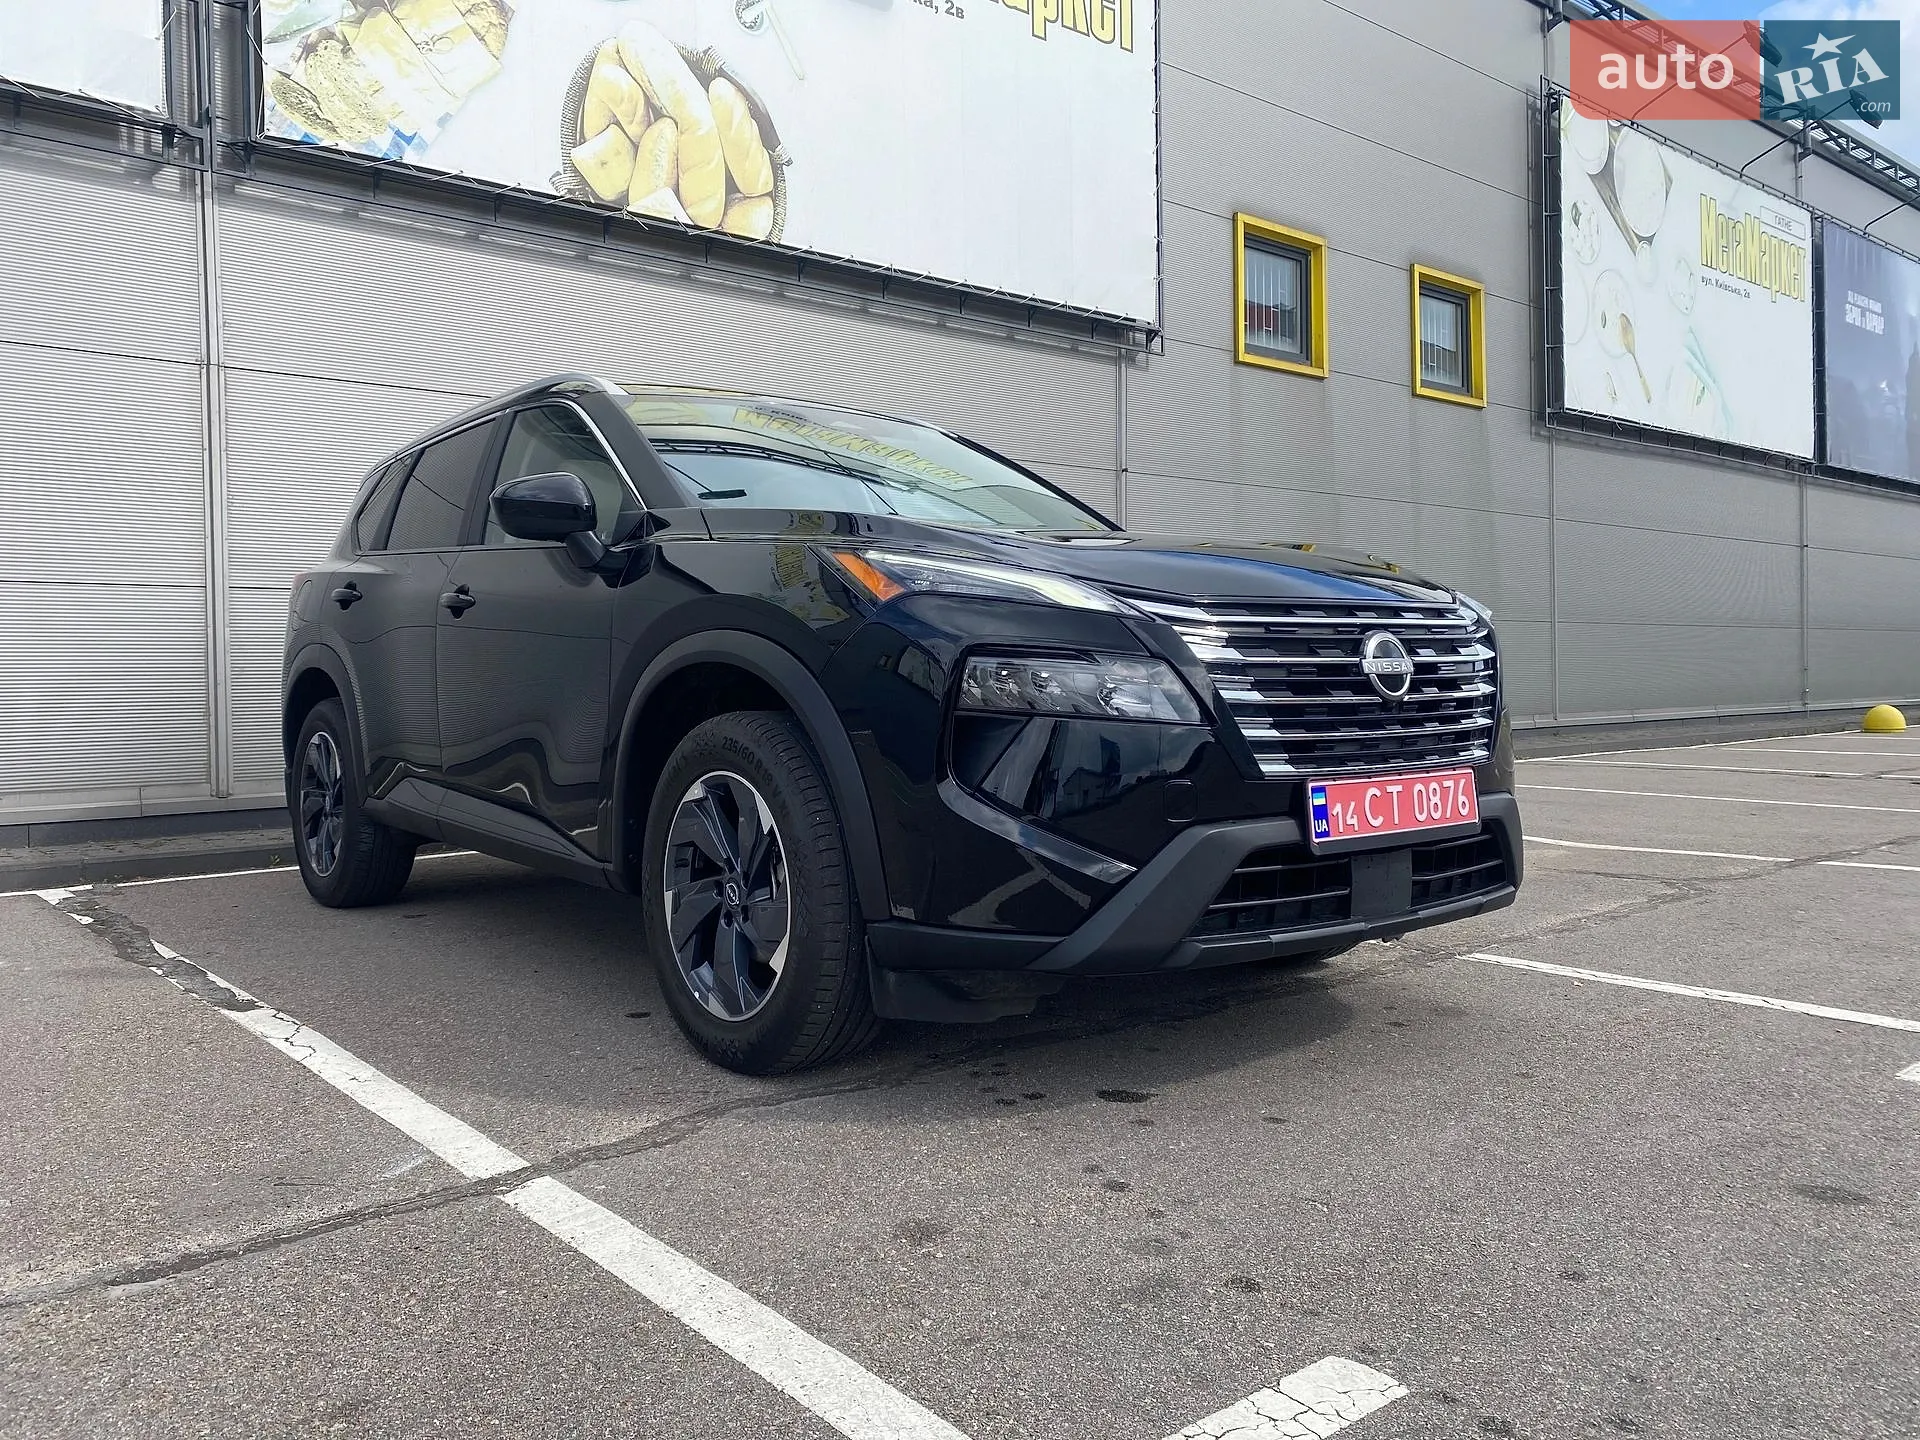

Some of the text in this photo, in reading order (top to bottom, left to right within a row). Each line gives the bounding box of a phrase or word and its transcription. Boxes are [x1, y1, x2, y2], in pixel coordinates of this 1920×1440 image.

[1700, 193, 1806, 303] МегаМаркет
[1413, 778, 1470, 822] 0876
[1315, 818, 1329, 833] UA
